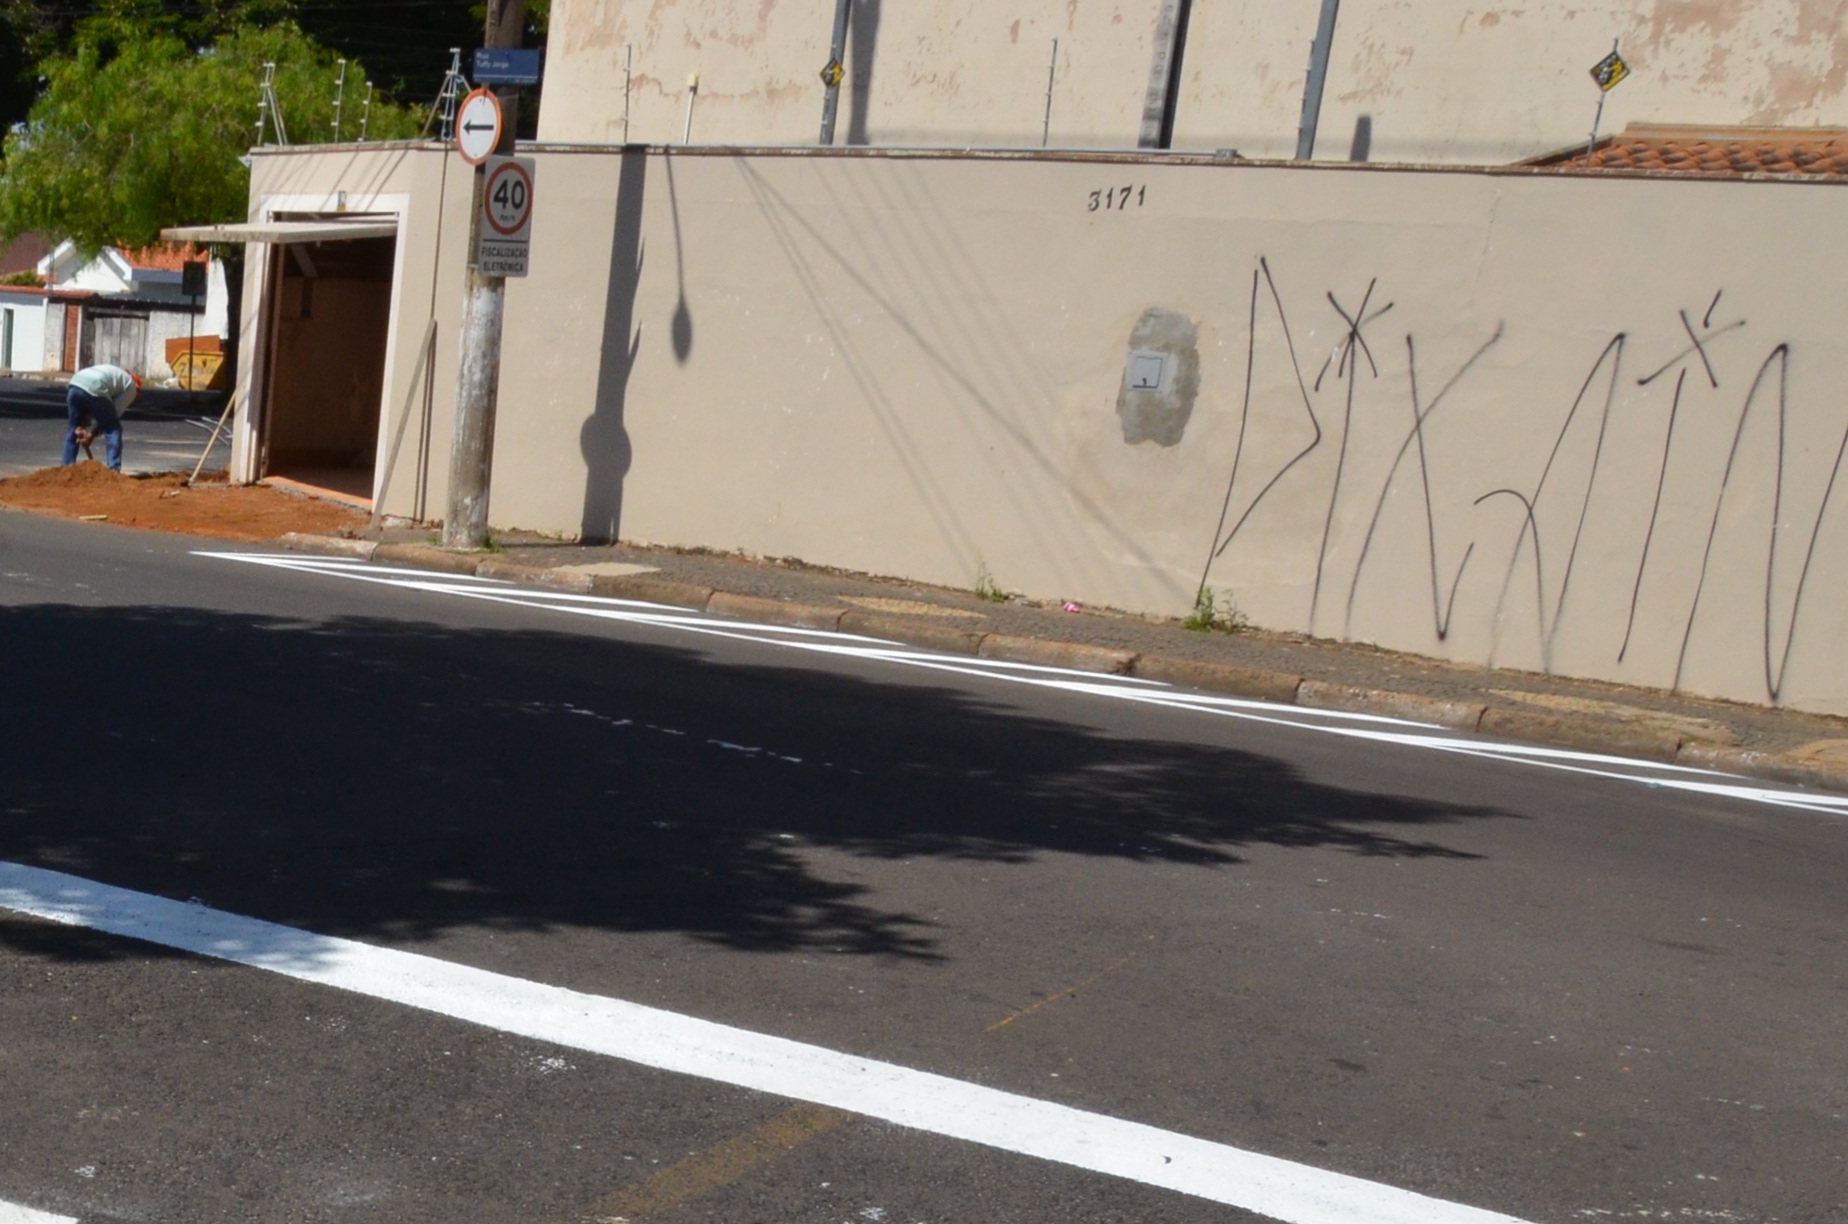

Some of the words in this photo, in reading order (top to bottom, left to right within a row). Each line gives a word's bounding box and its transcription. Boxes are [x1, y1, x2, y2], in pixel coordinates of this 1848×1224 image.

[493, 179, 526, 210] 40
[1087, 183, 1146, 212] 3171
[481, 245, 527, 259] FISCALIZAÇÃO
[483, 260, 523, 272] ELETRÔNICA
